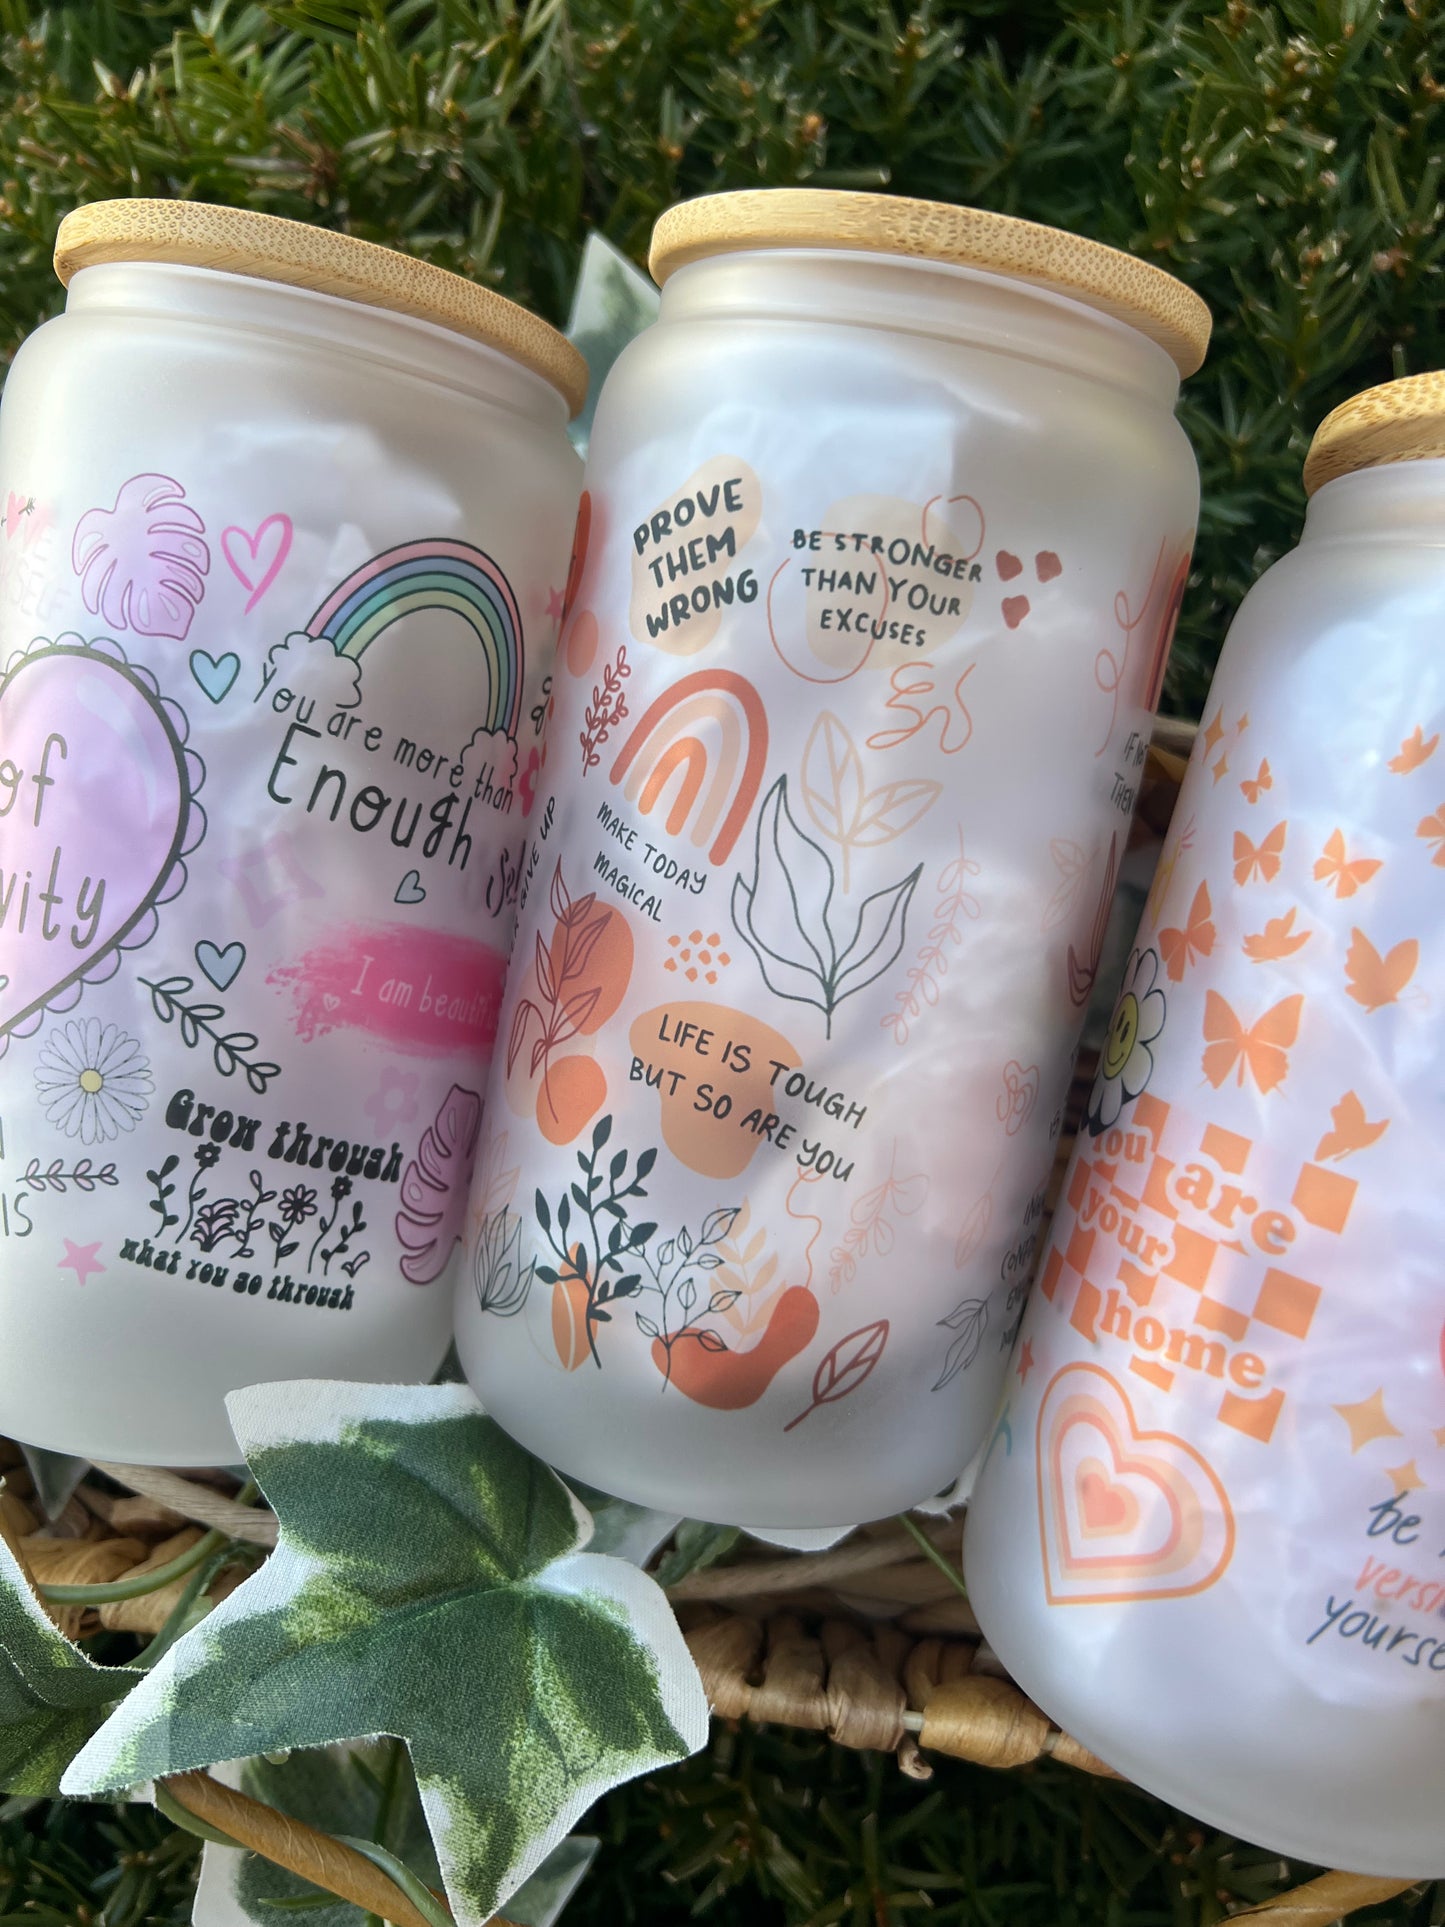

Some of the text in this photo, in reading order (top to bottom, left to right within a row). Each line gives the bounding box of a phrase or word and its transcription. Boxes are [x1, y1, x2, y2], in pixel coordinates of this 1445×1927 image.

[633, 477, 743, 556] PROVE
[648, 526, 736, 588] THEM
[793, 529, 982, 583] BE STRONGER
[801, 568, 962, 617] THAN YOUR
[645, 568, 759, 638] WRONG
[820, 608, 926, 648] EXCUSES
[267, 722, 473, 871] Enough
[326, 711, 383, 752] are
[393, 737, 464, 788] more
[474, 762, 514, 814] than
[540, 796, 555, 841] UP
[596, 801, 707, 895] MAKE TODAY
[593, 850, 662, 923] MAGICAL
[351, 955, 375, 996] I
[378, 978, 413, 1009] am
[658, 1013, 868, 1130] LIFE IS TOUGH
[165, 1088, 404, 1183] Grow through
[629, 1056, 855, 1183] BUT SO ARE YOU
[1081, 1185, 1168, 1267] your
[1174, 1162, 1297, 1256] are
[119, 1238, 182, 1275] what
[233, 1271, 263, 1296] go
[267, 1274, 355, 1312] through
[1100, 1287, 1266, 1389] home
[1366, 1490, 1422, 1544] be
